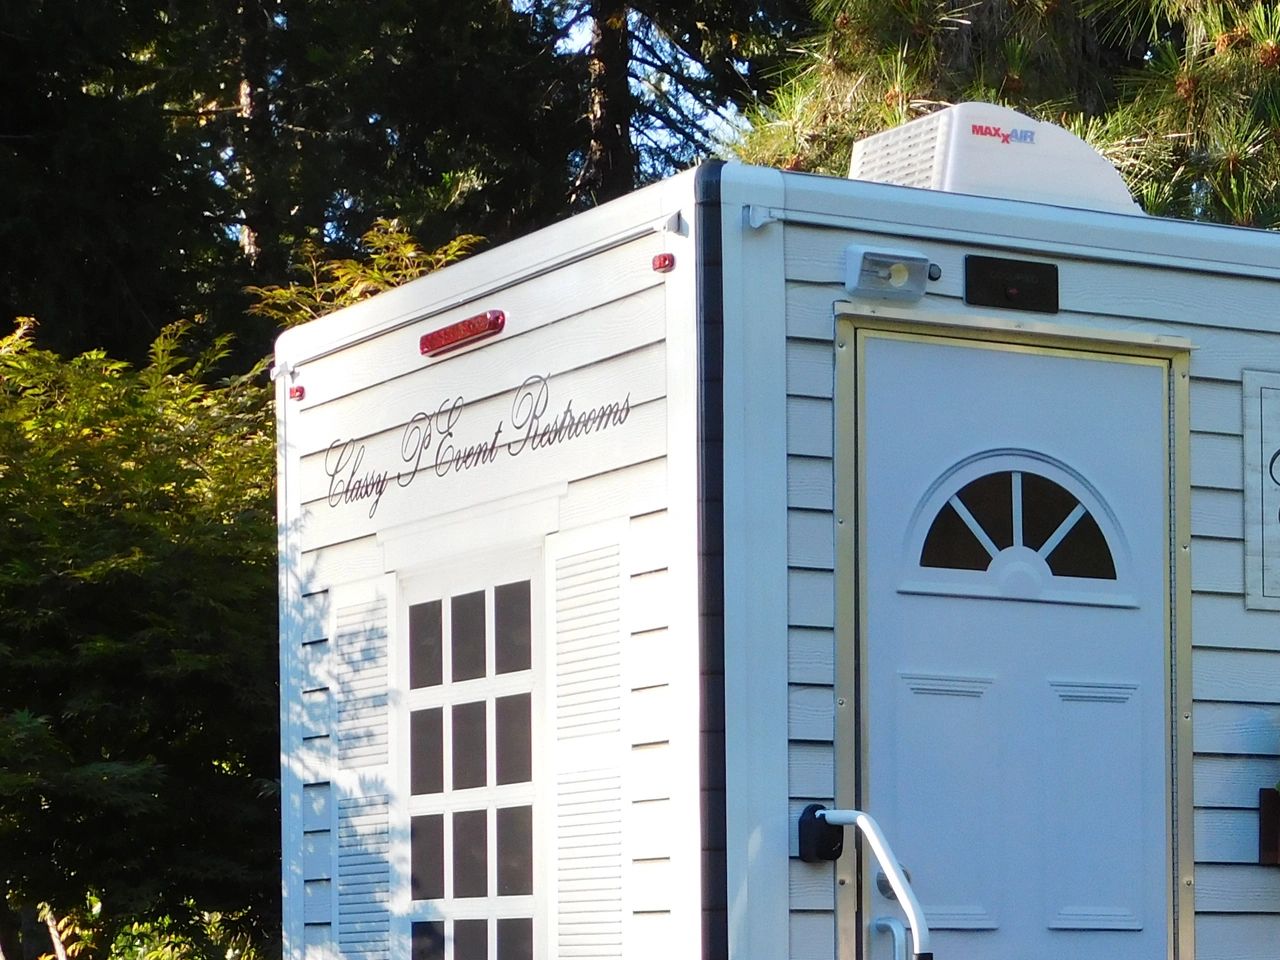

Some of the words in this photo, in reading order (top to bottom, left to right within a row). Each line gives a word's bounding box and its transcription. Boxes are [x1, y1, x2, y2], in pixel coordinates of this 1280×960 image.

[324, 438, 389, 519] Classy
[397, 410, 437, 488] P
[435, 395, 502, 478] Event
[507, 372, 632, 457] Restrooms
